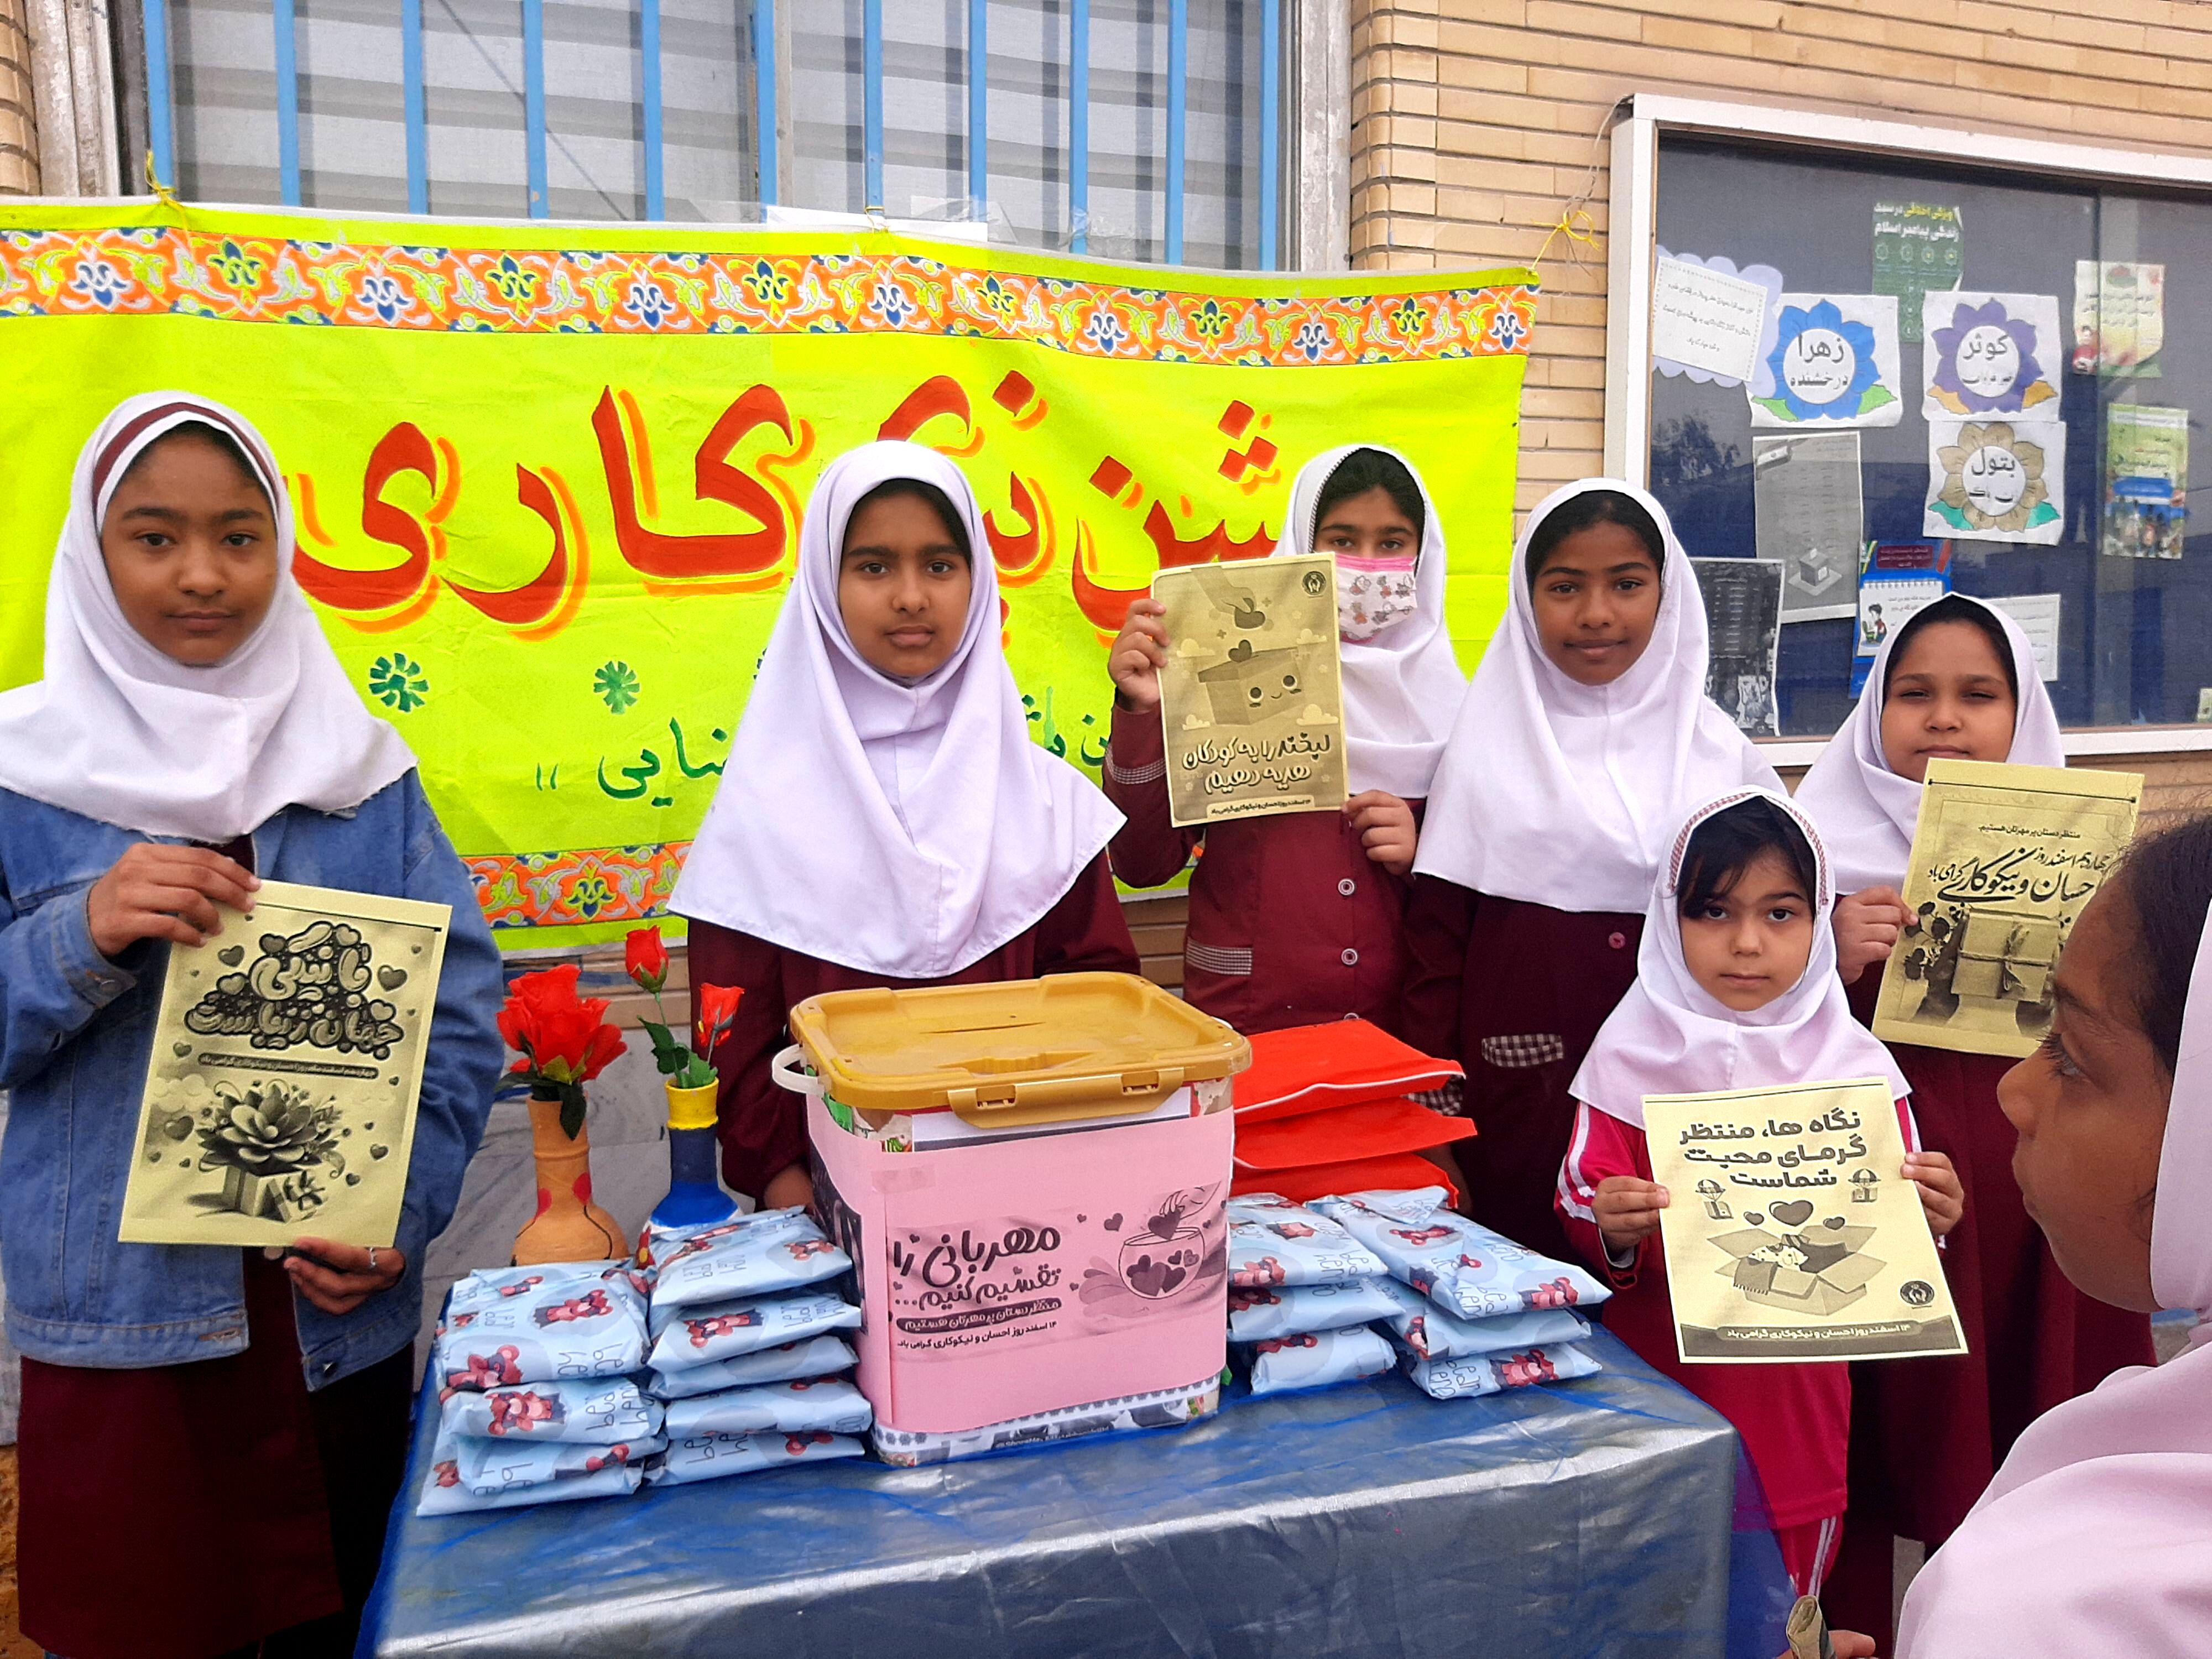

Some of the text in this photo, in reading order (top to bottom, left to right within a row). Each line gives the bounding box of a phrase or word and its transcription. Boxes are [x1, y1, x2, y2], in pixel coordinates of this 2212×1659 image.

[1798, 332, 1844, 363] زهرا
[1963, 333, 2008, 361] کوثر
[1971, 447, 2015, 478] بتول
[1182, 732, 1331, 769] لبخند را به کودکان
[1204, 765, 1312, 795] هدیه دهیم
[2037, 828, 2059, 837] دستان
[2059, 830, 2081, 839] منتظر
[2033, 847, 2048, 864] روز
[2044, 849, 2077, 868] اسفند
[1928, 864, 1938, 882] باد
[2030, 871, 2094, 902] حسان
[1809, 1107, 1861, 1133] نگاه
[1679, 1123, 1755, 1145] منتظر
[1684, 1133, 1867, 1169] گرمای محبت
[1729, 1168, 1838, 1188] شماست
[922, 1227, 1061, 1288] مهربانی
[975, 1263, 1062, 1304] تقسیم
[996, 1306, 1029, 1321] دستان
[1029, 1300, 1059, 1316] منتظر
[905, 1318, 948, 1331] هستیم
[1011, 1327, 1024, 1337] روز
[1025, 1323, 1047, 1333] اسفند
[1855, 1328, 1869, 1336] روز
[1870, 1324, 1900, 1333] اسفند
[975, 1335, 980, 1344] و
[982, 1328, 1010, 1342] احسان
[1728, 1329, 1740, 1338] باد
[1740, 1328, 1769, 1339] گرامی
[1770, 1329, 1813, 1339] نیکوکاری
[1821, 1328, 1854, 1338] احسان
[910, 1339, 932, 1348] گرامی
[933, 1334, 974, 1348] نیکوکاری
